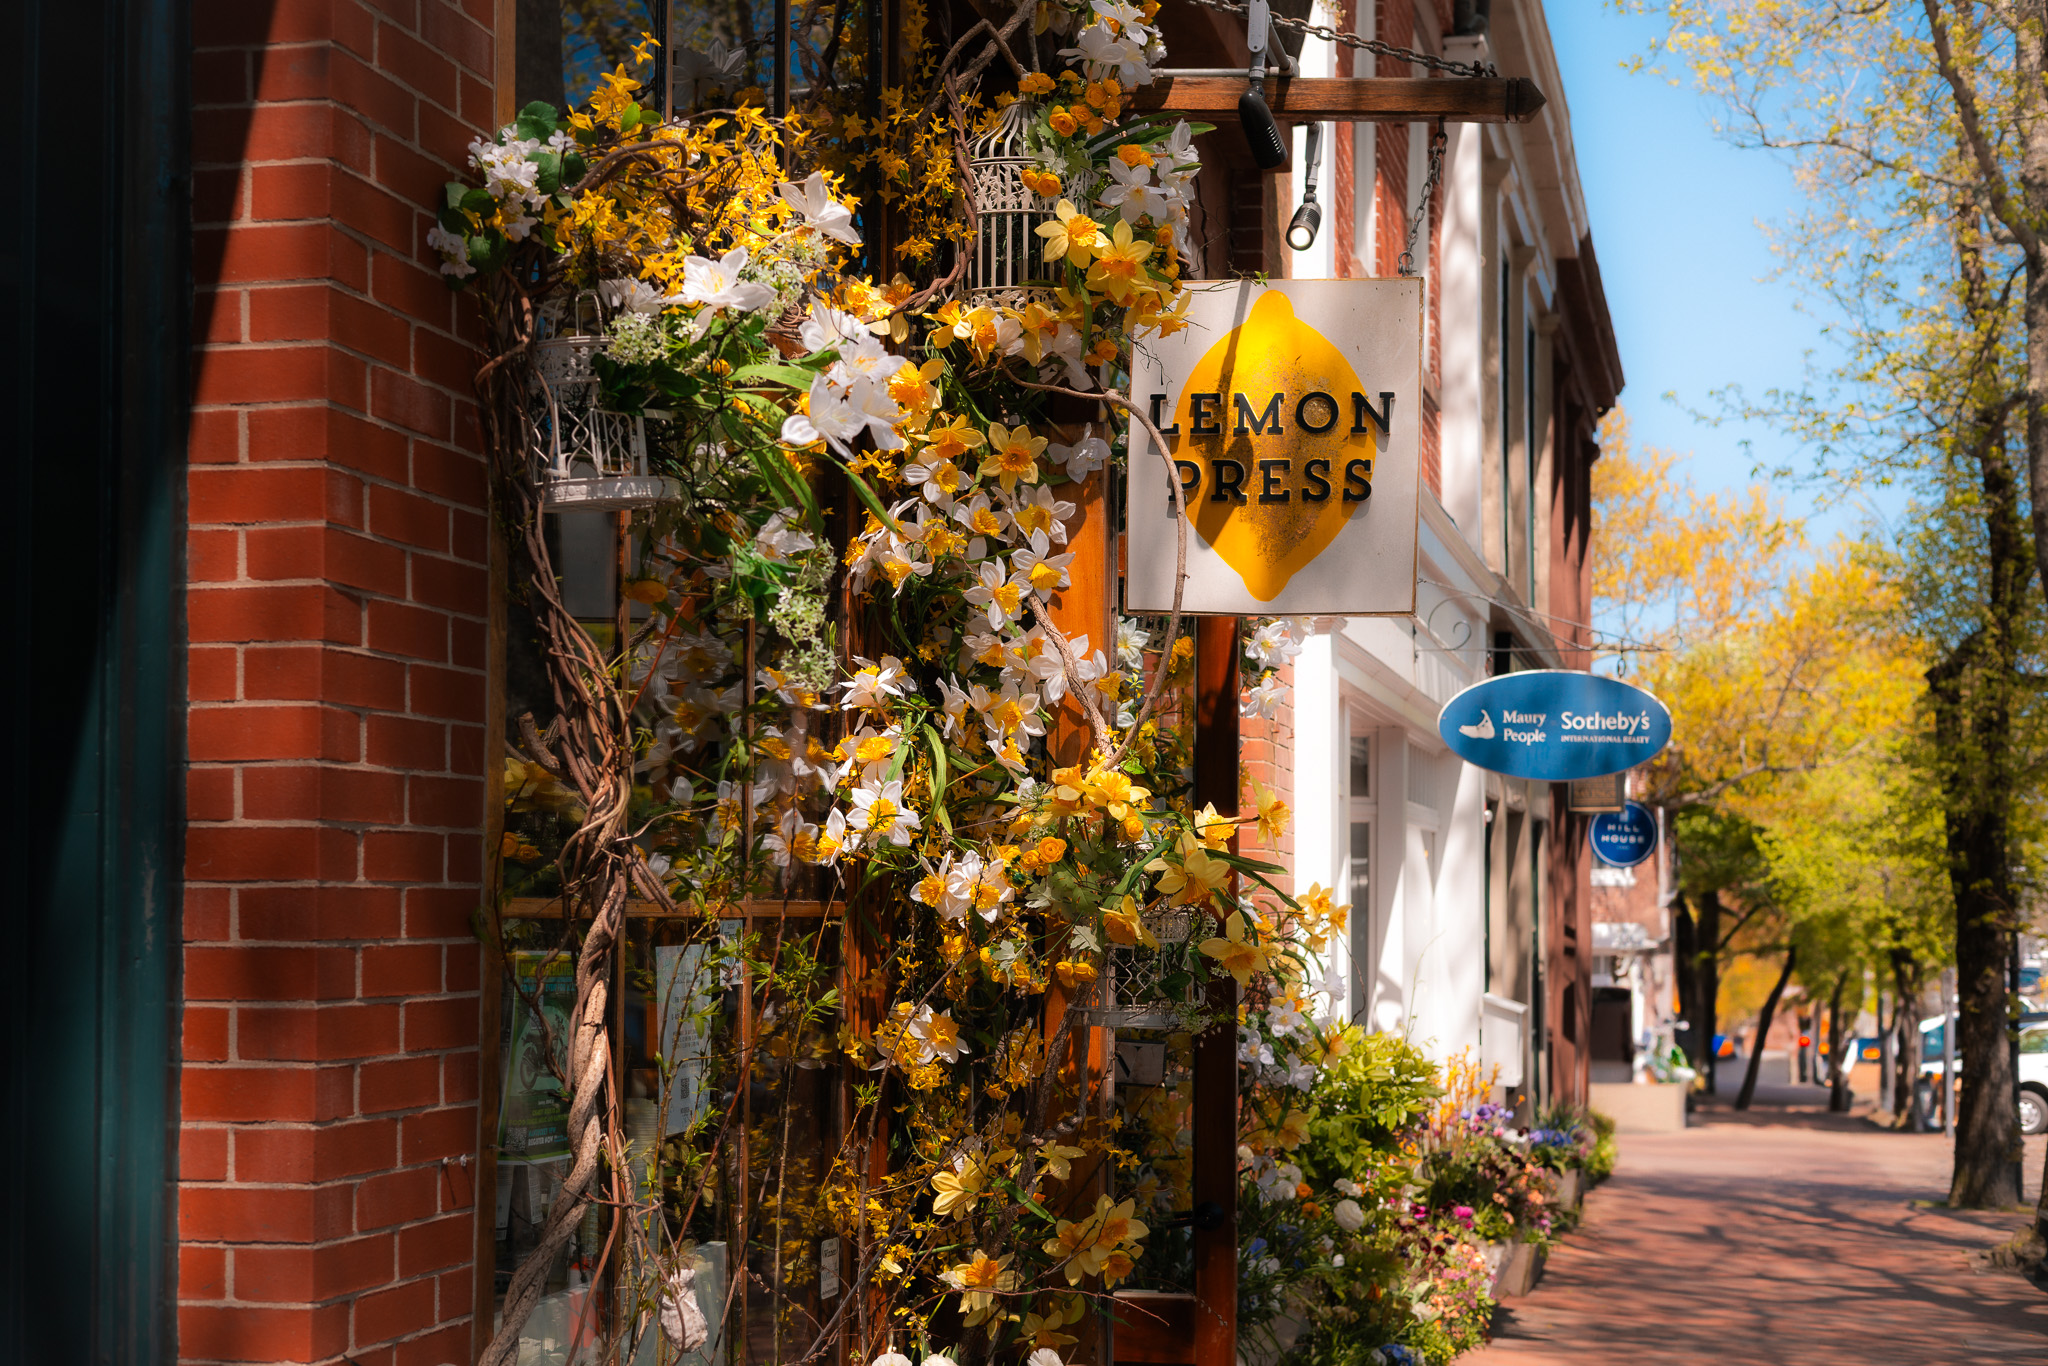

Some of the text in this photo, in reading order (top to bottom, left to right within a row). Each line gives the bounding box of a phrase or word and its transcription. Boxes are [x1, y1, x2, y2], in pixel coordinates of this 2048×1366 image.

[1150, 391, 1395, 436] LEMON
[1168, 458, 1374, 502] PRESS
[1502, 710, 1547, 728] Maury
[1560, 710, 1650, 735] Sotheby's
[1502, 728, 1547, 746] People
[1560, 735, 1650, 745] INTERNATIONAL REALTY
[1607, 823, 1640, 833] HILL
[1601, 834, 1646, 844] HOUSE
